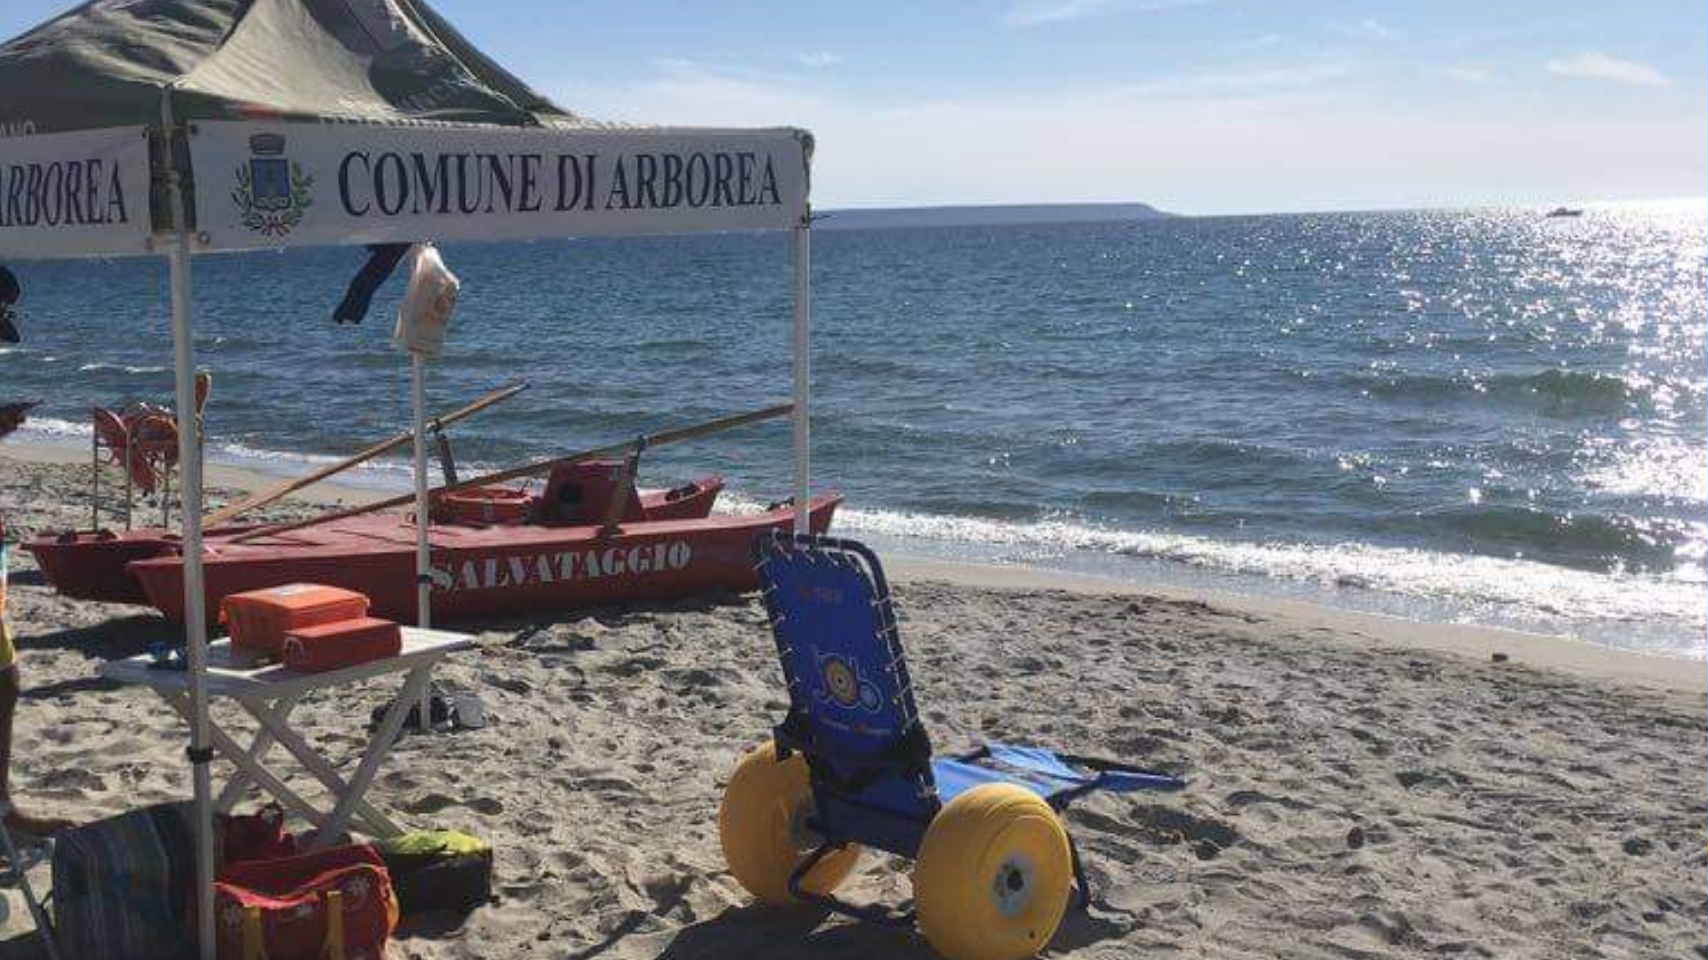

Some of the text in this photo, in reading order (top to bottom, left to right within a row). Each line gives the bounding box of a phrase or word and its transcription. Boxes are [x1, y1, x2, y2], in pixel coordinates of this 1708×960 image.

[0, 159, 129, 228] RBOREA
[338, 150, 783, 217] COMUNE DI ARBOREA
[428, 540, 692, 593] SALVATAGGIO
